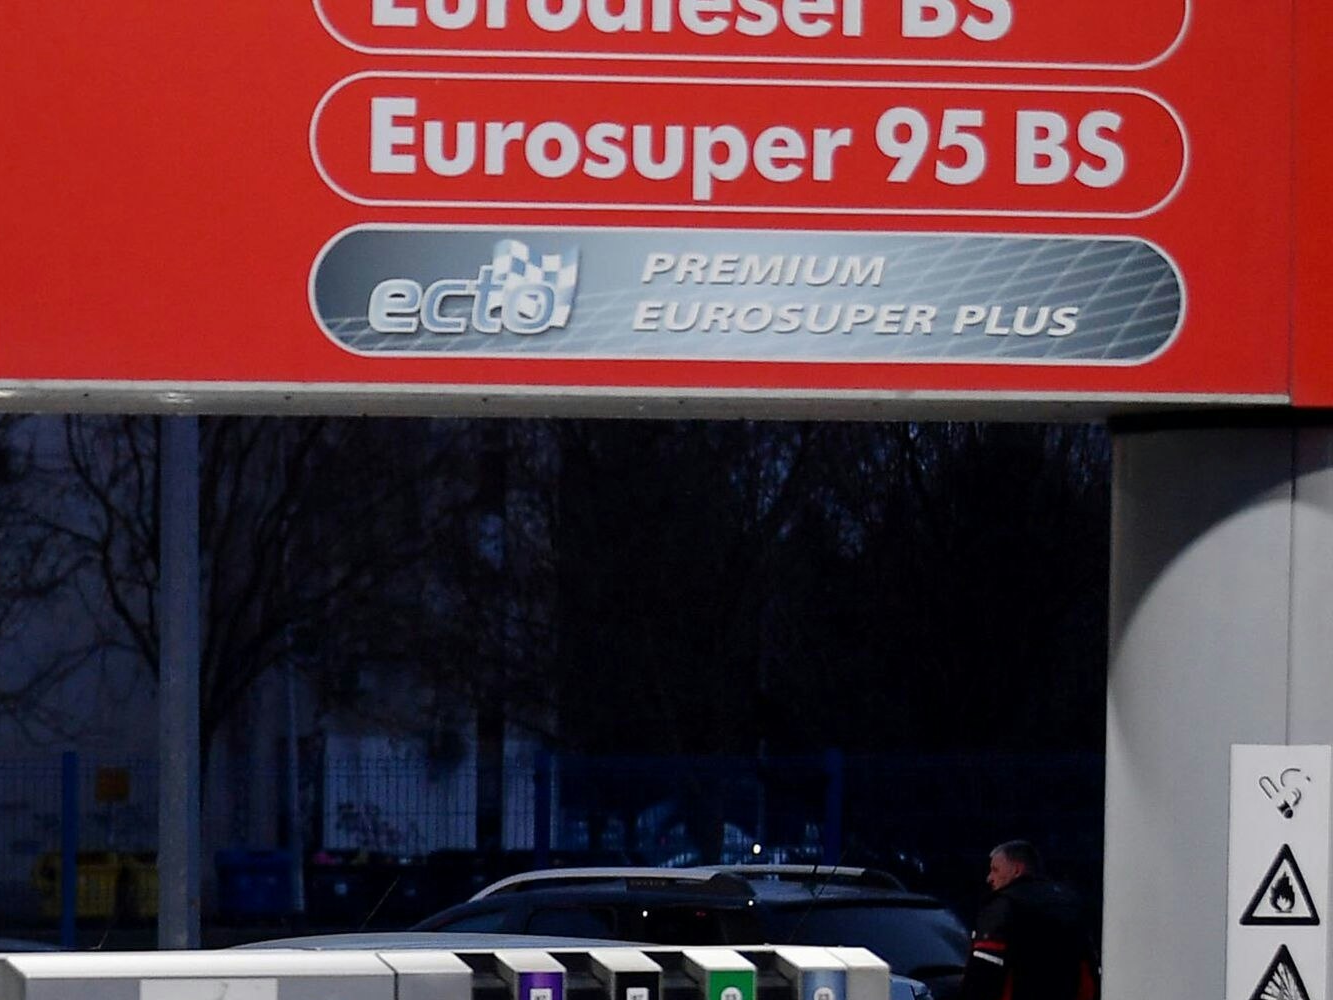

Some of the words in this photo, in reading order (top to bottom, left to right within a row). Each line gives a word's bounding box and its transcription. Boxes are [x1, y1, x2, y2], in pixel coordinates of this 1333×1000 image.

[370, 97, 853, 201] Eurosuper
[875, 106, 986, 186] 95
[1015, 109, 1125, 189] BS
[641, 252, 886, 288] PREMIUM
[368, 262, 557, 334] ecto
[632, 300, 937, 336] EUROSUPER
[952, 304, 1080, 338] PLUS
